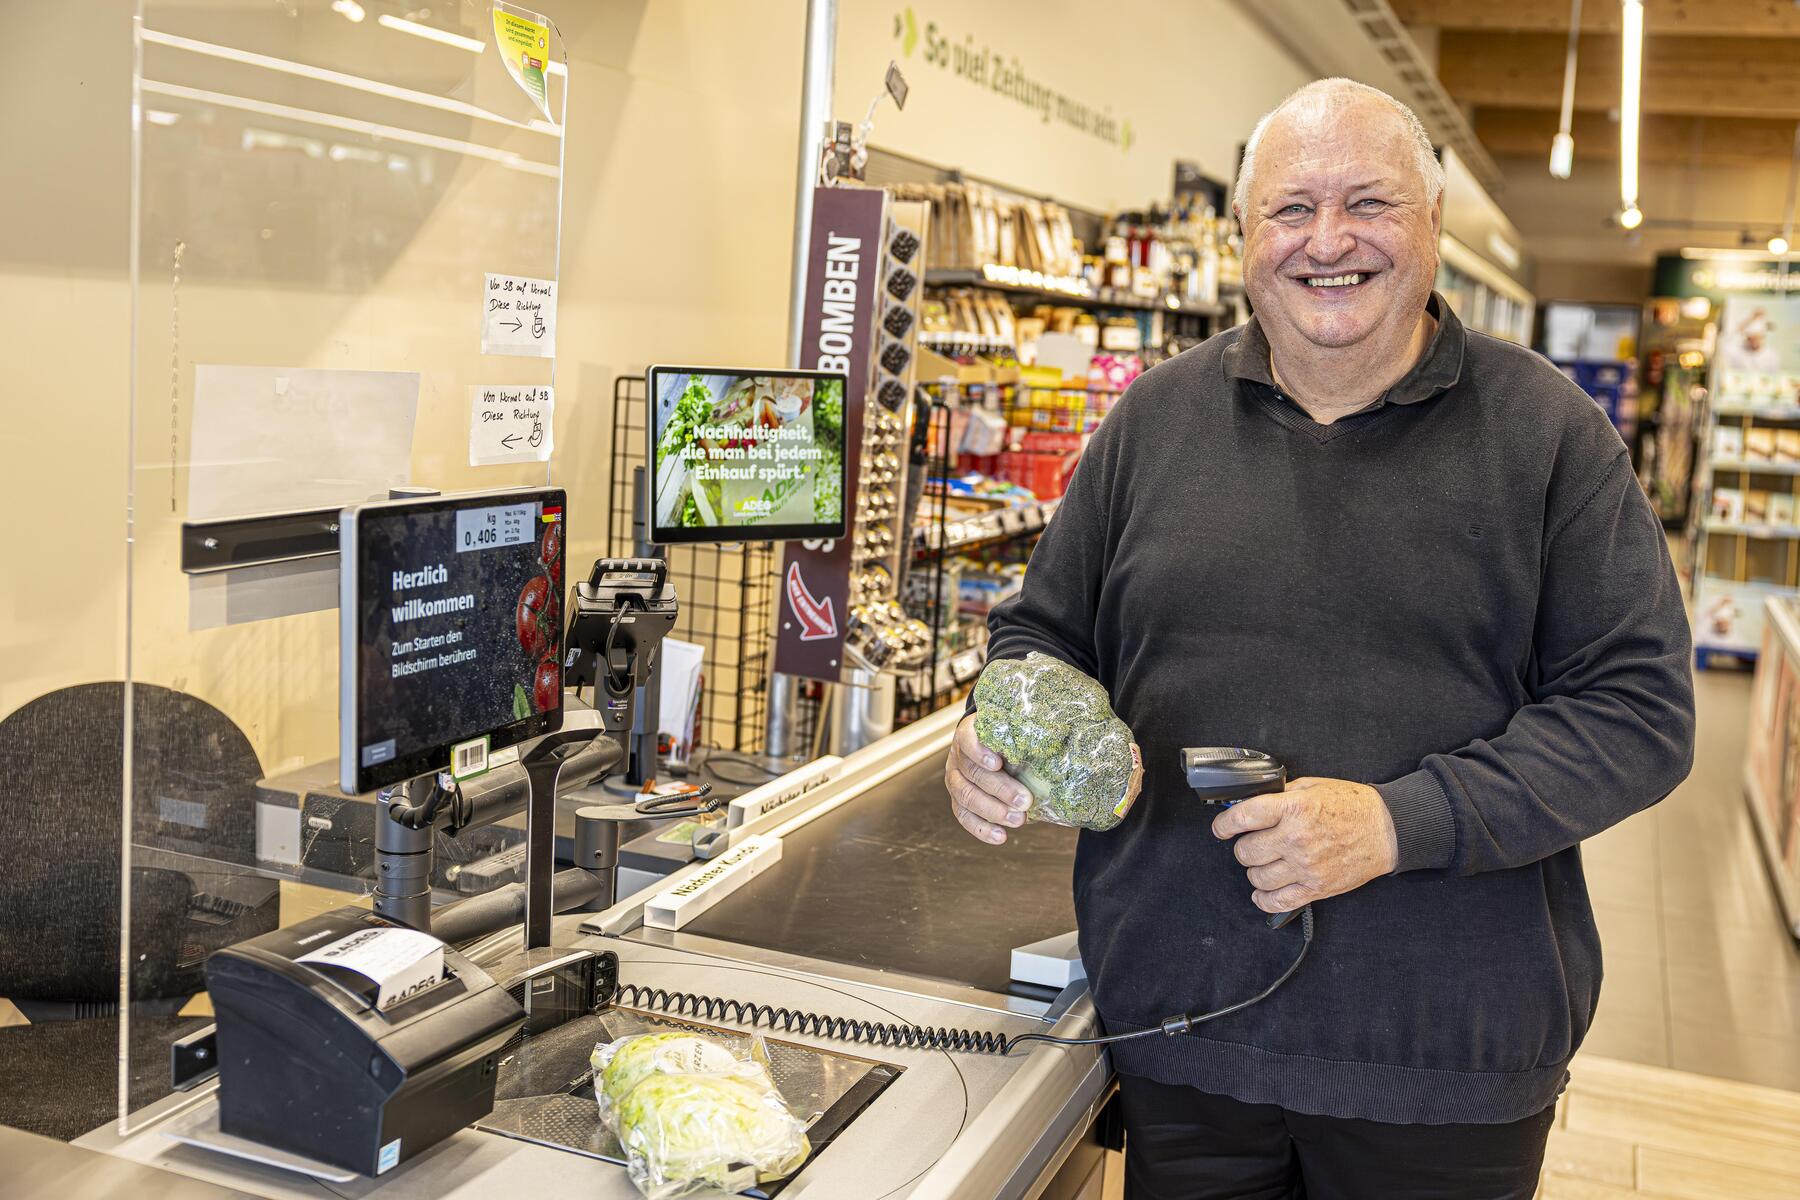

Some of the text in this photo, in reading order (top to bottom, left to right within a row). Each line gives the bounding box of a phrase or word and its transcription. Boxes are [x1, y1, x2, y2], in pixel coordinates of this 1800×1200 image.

[924, 21, 949, 68] So
[953, 34, 989, 87] viel
[991, 54, 1056, 125] Zeitung
[490, 278, 551, 297] Von SB auf Normal
[489, 298, 541, 318] Diese Richtung
[483, 388, 549, 403] Von Normal auf SB
[481, 408, 540, 424] Diese Richtung
[680, 442, 822, 462] die man bei jedem
[695, 463, 757, 480] Einkauf
[486, 513, 496, 525] kg
[465, 528, 497, 546] 0.406
[393, 563, 448, 591] Herzlich
[392, 594, 475, 623] willkommen
[392, 631, 462, 656] Zum Starten den
[392, 648, 477, 678] Bildschirm berühren
[671, 865, 727, 897] Nächster
